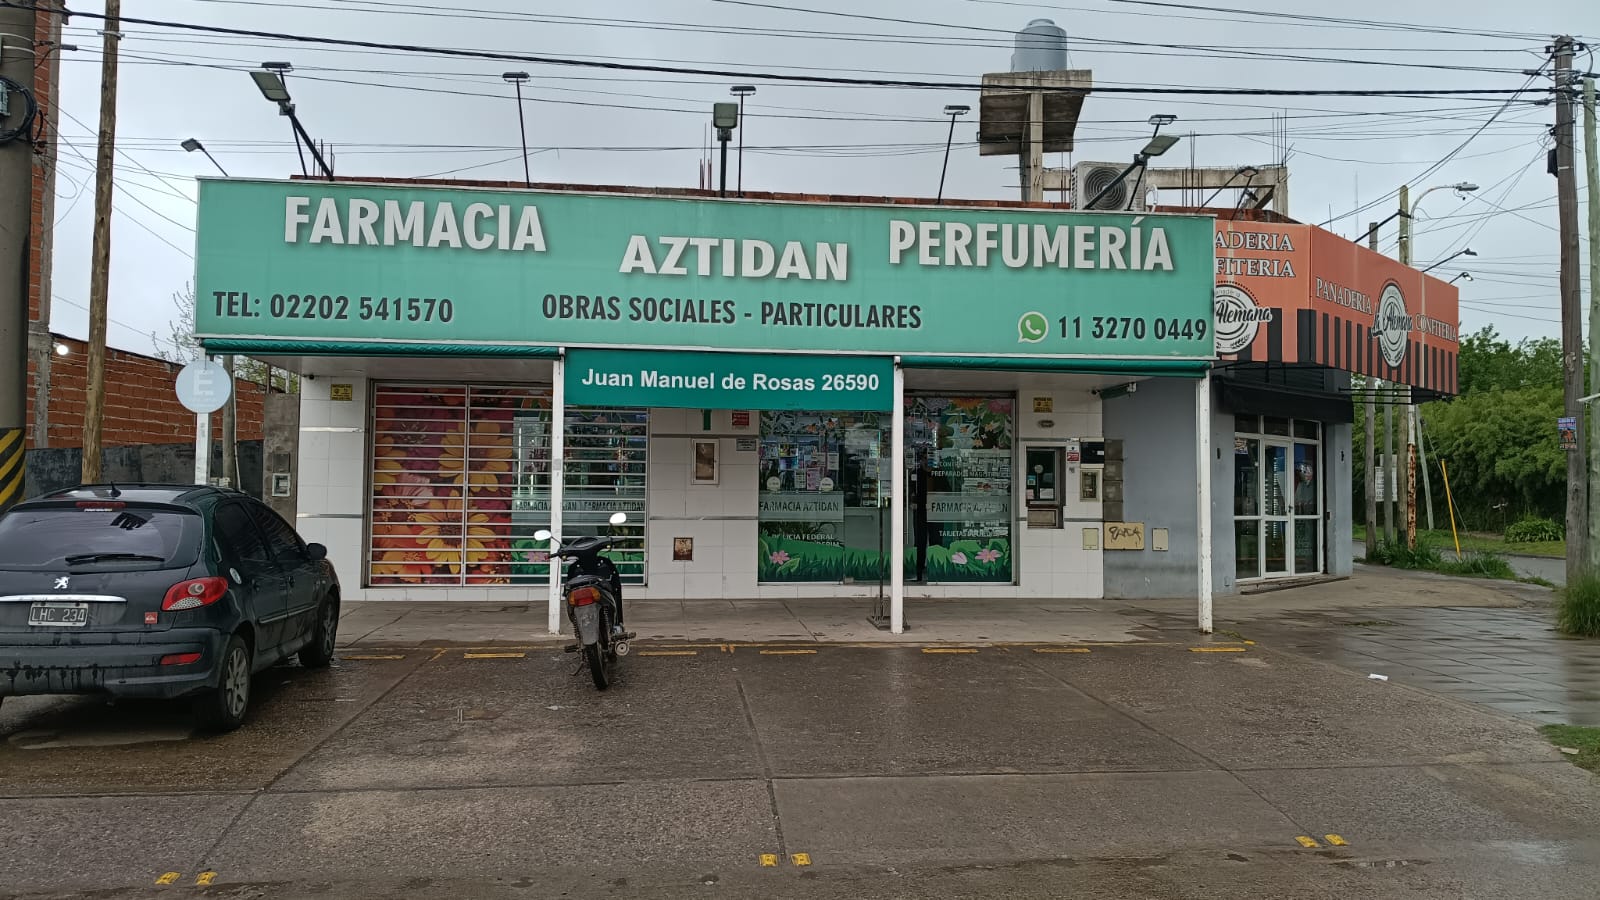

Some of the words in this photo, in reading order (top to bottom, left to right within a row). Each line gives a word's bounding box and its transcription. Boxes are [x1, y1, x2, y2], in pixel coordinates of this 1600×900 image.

[284, 196, 547, 252] FARMACIA
[889, 216, 1174, 271] PERFUMERÍA
[1216, 231, 1295, 251] ADERIA
[619, 235, 848, 281] AZTIDAN
[1216, 257, 1296, 277] FITERIA
[213, 291, 260, 318] TEL:
[270, 294, 349, 320] 02202
[359, 297, 454, 323] 541570
[1315, 277, 1373, 315] PANADERIA
[542, 294, 621, 321] OBRAS
[629, 297, 736, 324] SOCIALES
[761, 301, 922, 329] PARTICULARES
[1216, 302, 1271, 324] Alemana
[1058, 316, 1081, 339] 11
[1091, 317, 1146, 339] 3270
[1154, 318, 1207, 340] 0449
[1415, 313, 1457, 342] CONFITERIA
[581, 368, 633, 388] Juan
[640, 370, 715, 390] Manuel
[721, 372, 746, 390] de
[753, 373, 816, 392] Rosas
[821, 374, 880, 392] 26590
[760, 502, 801, 511] FARMACIA
[803, 502, 839, 512] AZTIDAN
[802, 533, 835, 541] FEDERAL
[32, 608, 56, 621] LHC
